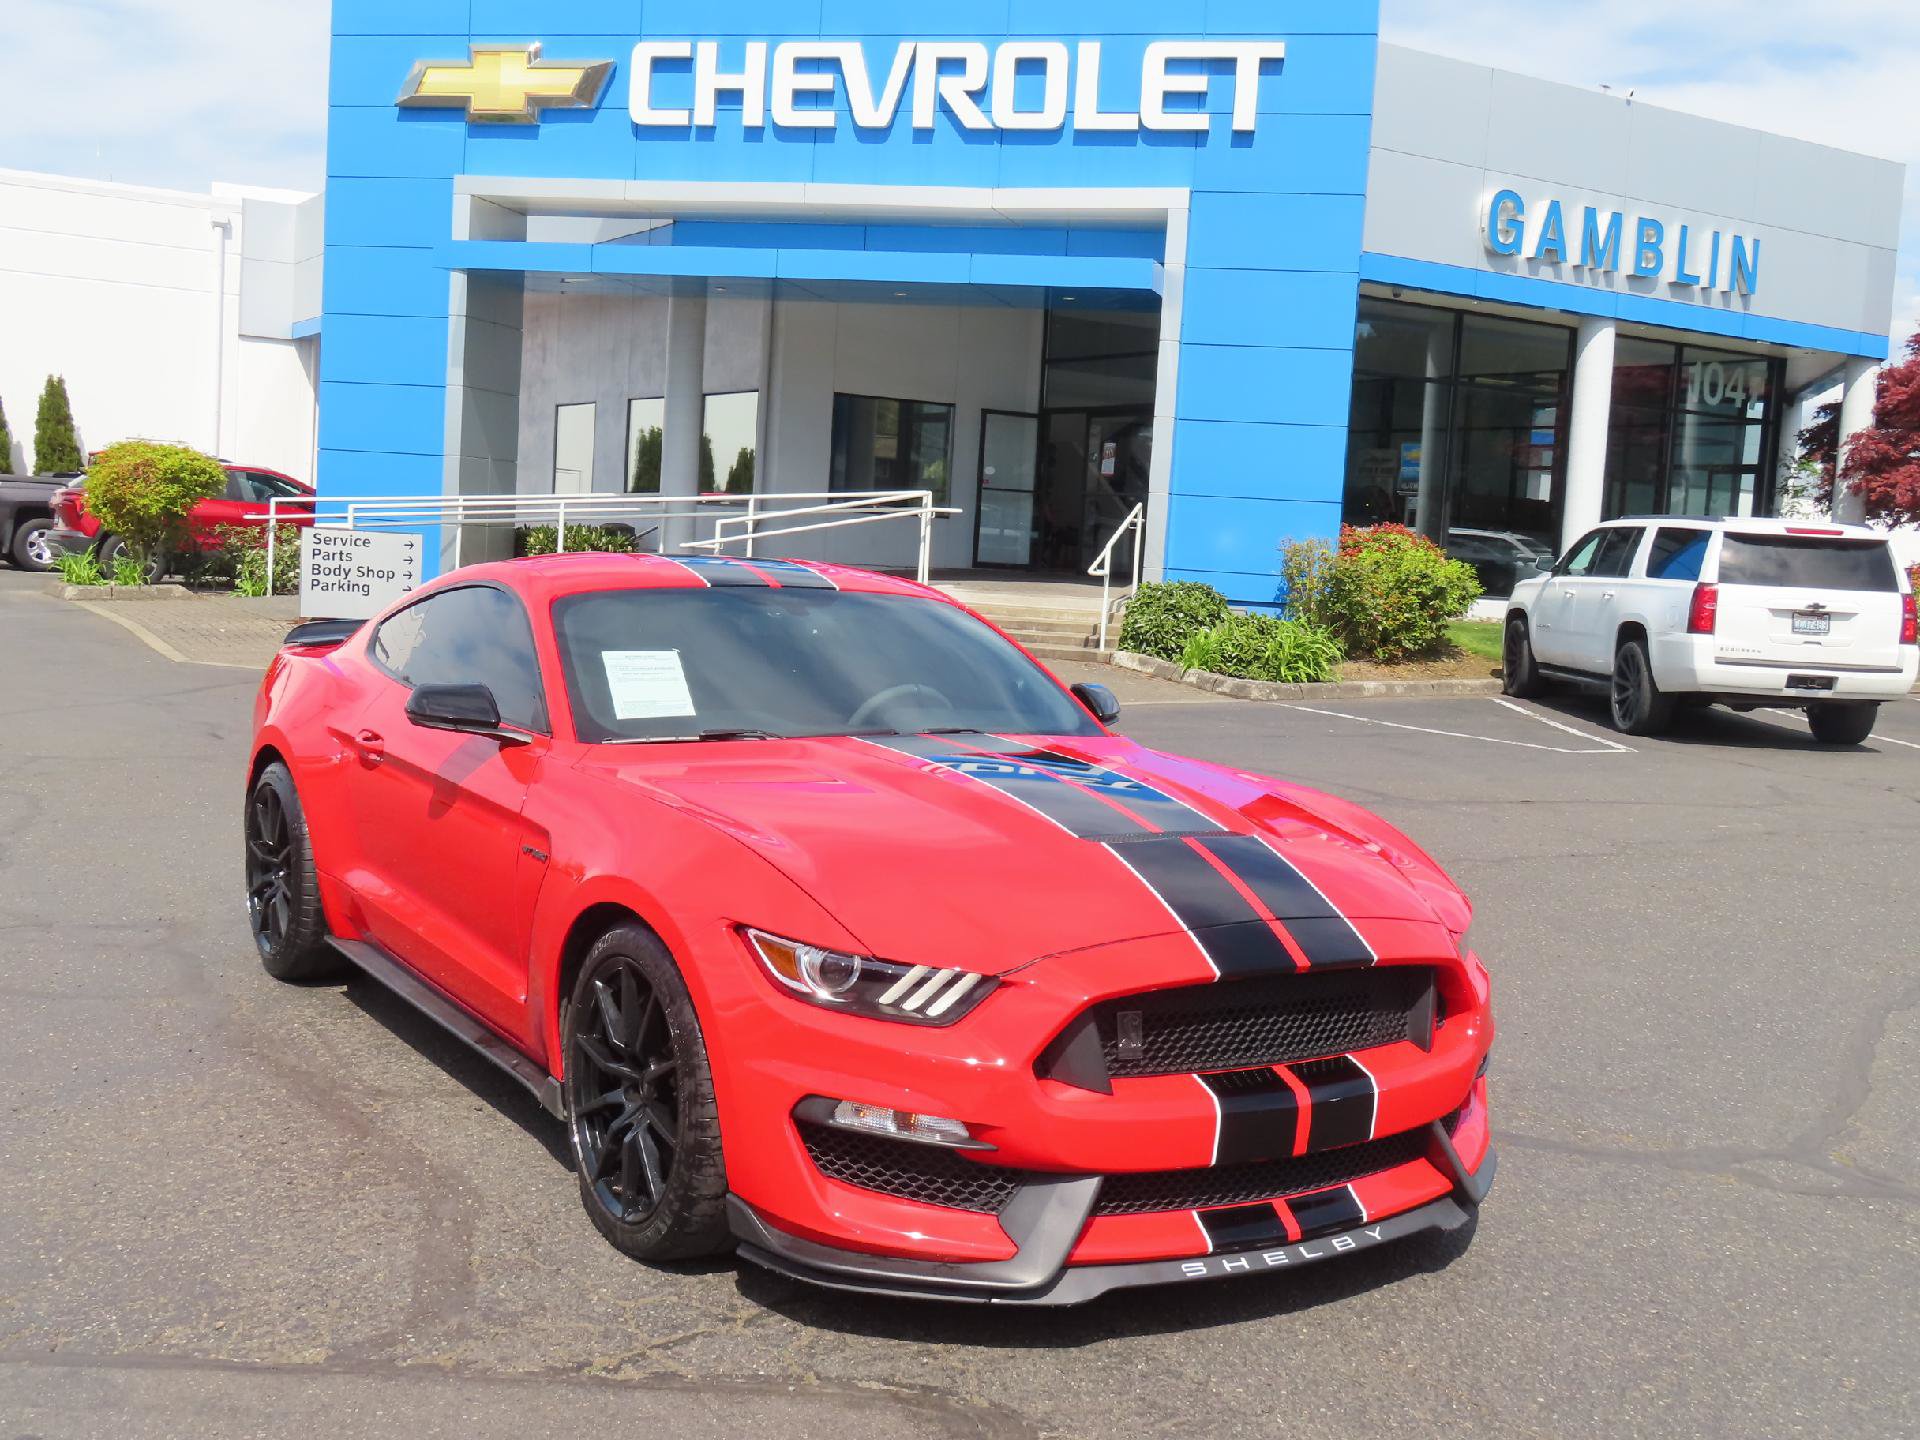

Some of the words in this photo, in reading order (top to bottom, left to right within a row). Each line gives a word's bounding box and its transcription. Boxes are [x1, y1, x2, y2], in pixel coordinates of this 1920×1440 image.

[628, 41, 1285, 133] CHEVROLET
[1487, 189, 1760, 296] GAMBLIN
[312, 533, 371, 548] Service
[312, 548, 353, 562] Parts
[311, 563, 352, 580] Body
[356, 566, 396, 582] Shop
[310, 578, 370, 597] Parking
[1181, 1226, 1382, 1277] SHELBY
